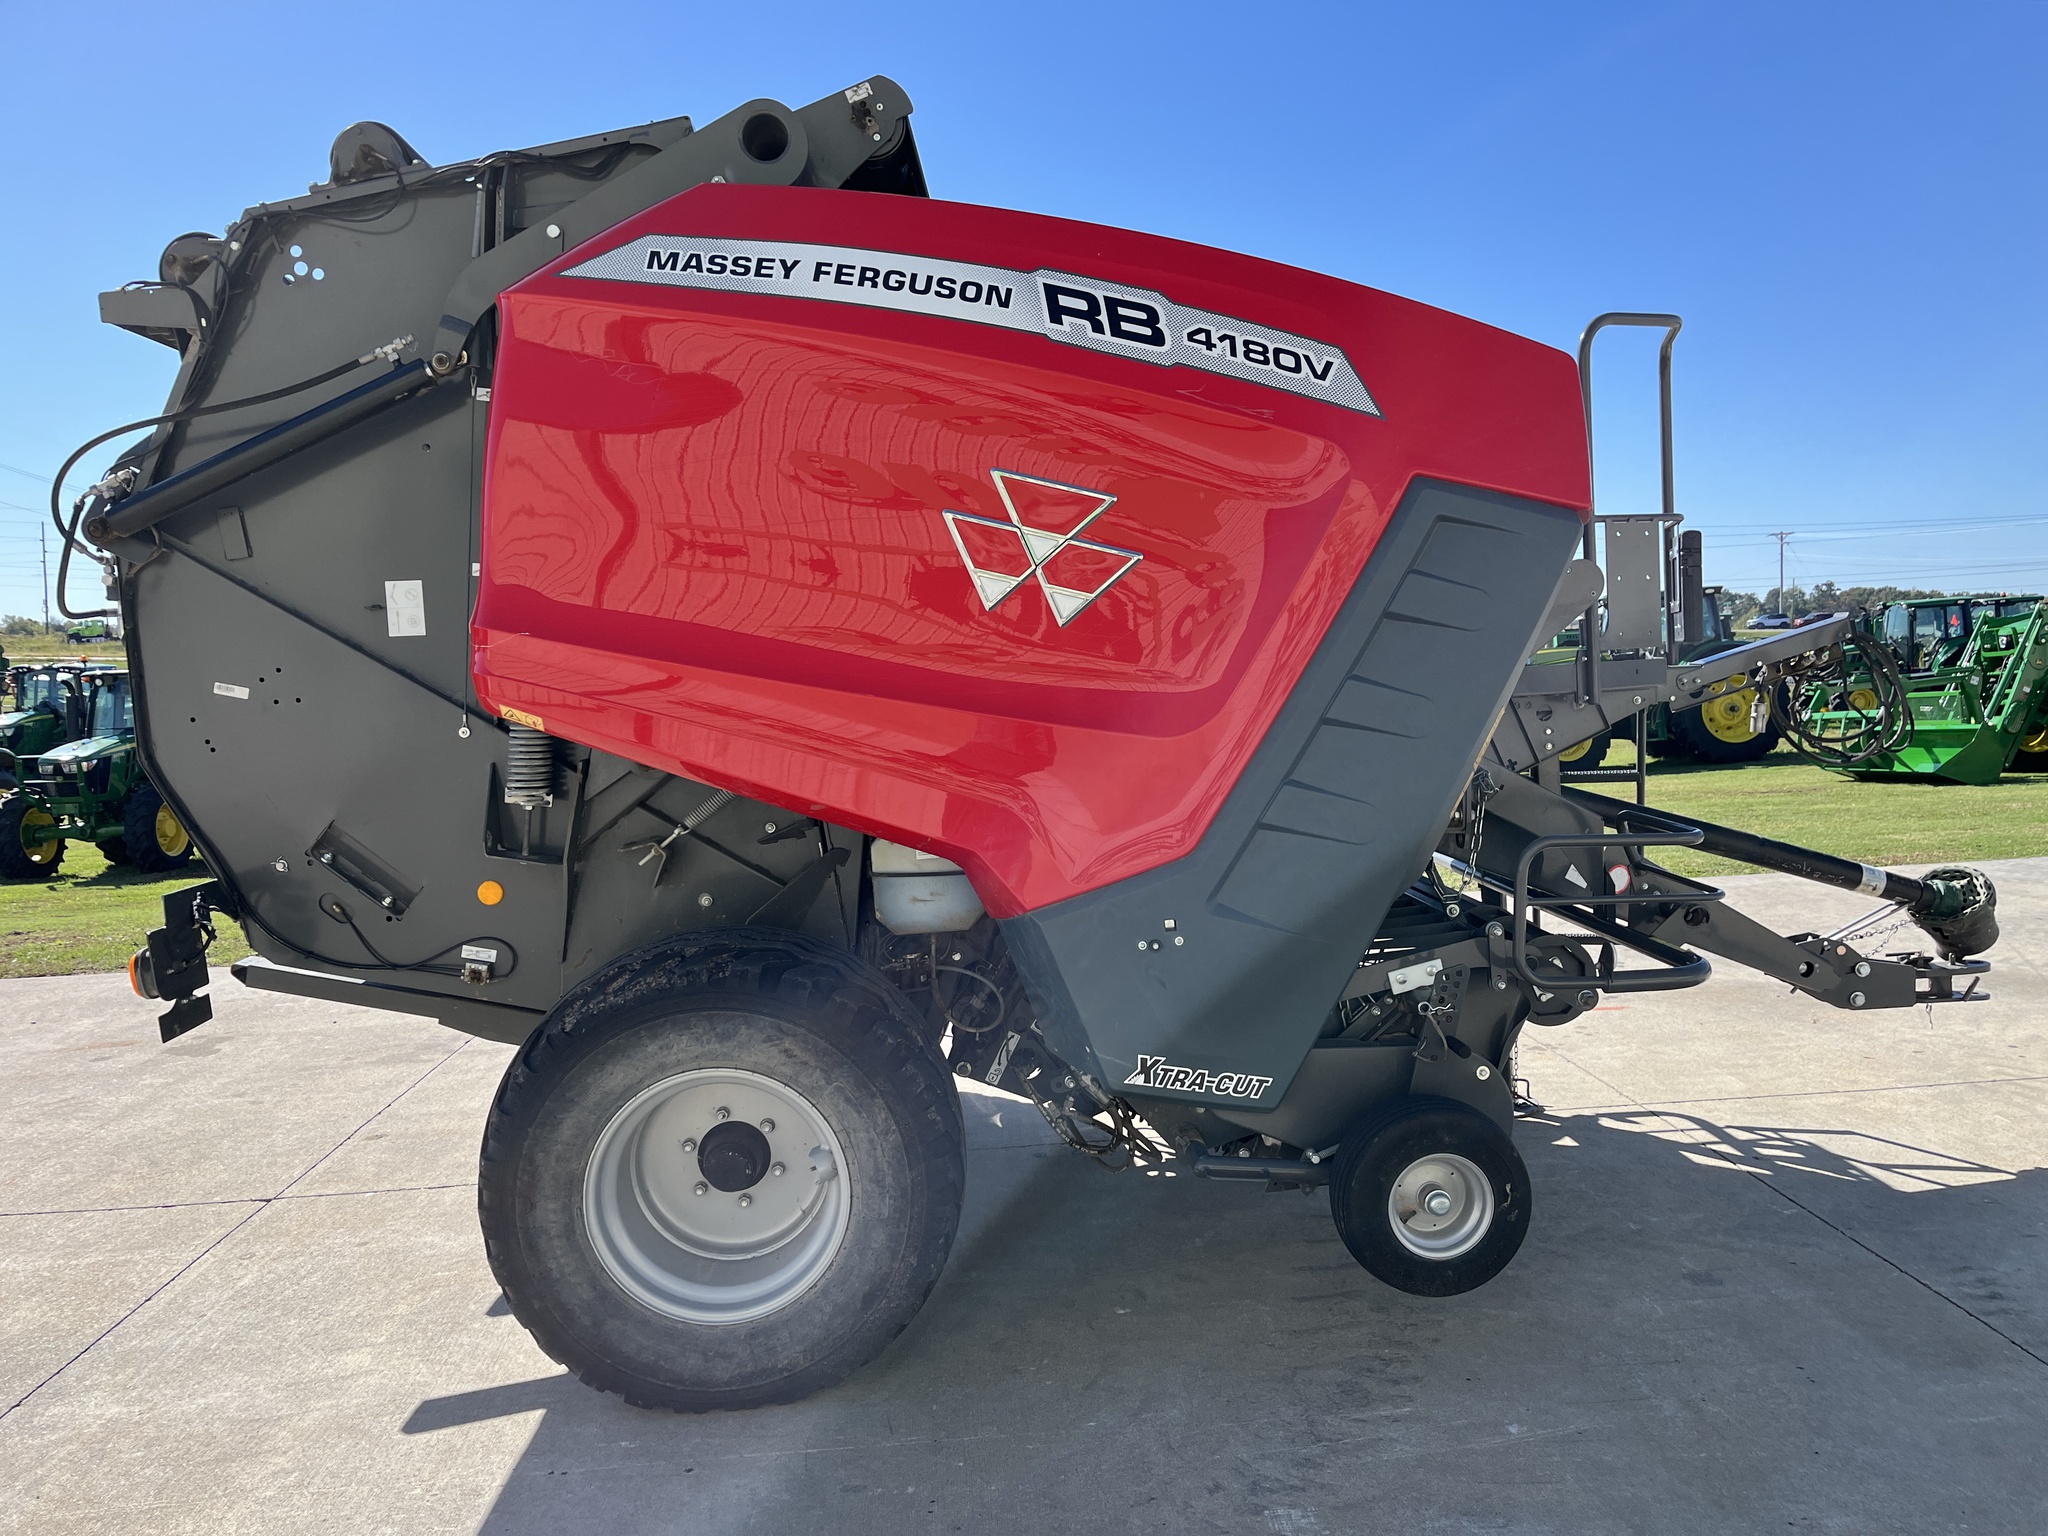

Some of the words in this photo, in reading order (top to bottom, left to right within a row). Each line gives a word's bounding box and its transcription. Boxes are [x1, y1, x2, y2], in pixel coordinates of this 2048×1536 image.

[646, 249, 800, 280] MASSEY
[812, 261, 1013, 309] FERGUSON
[1042, 282, 1166, 348] RB
[1186, 327, 1335, 382] 4180V
[1124, 1054, 1273, 1099] XTRA-CUT
